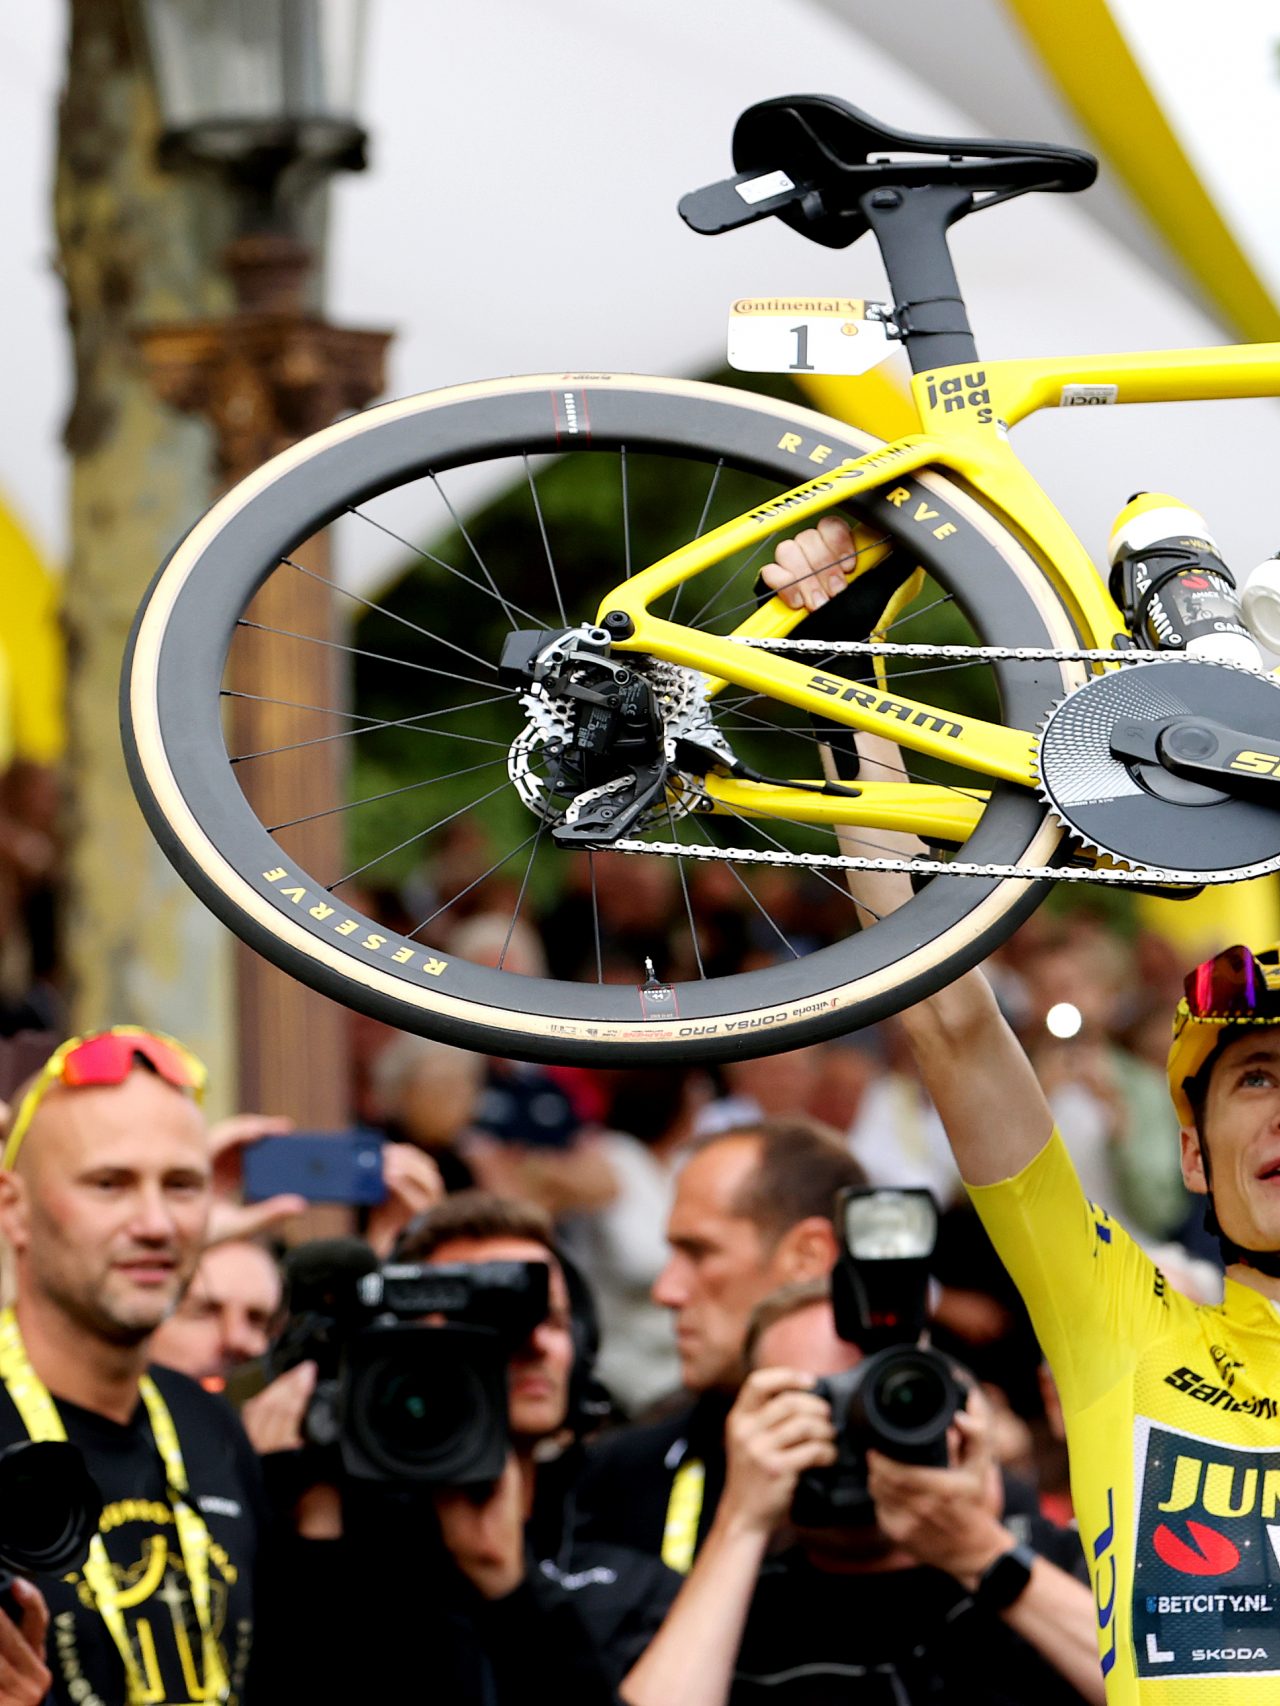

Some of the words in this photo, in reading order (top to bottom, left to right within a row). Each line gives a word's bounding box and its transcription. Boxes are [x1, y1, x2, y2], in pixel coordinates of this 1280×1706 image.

[734, 299, 840, 314] Continental
[788, 324, 815, 371] 1
[806, 675, 964, 739] SRAM
[262, 866, 449, 977] RESERVE
[678, 1024, 718, 1038] PRO
[724, 1012, 788, 1032] CORSA
[1092, 1487, 1117, 1680] LCL
[1158, 1594, 1274, 1614] BETCITY.NL
